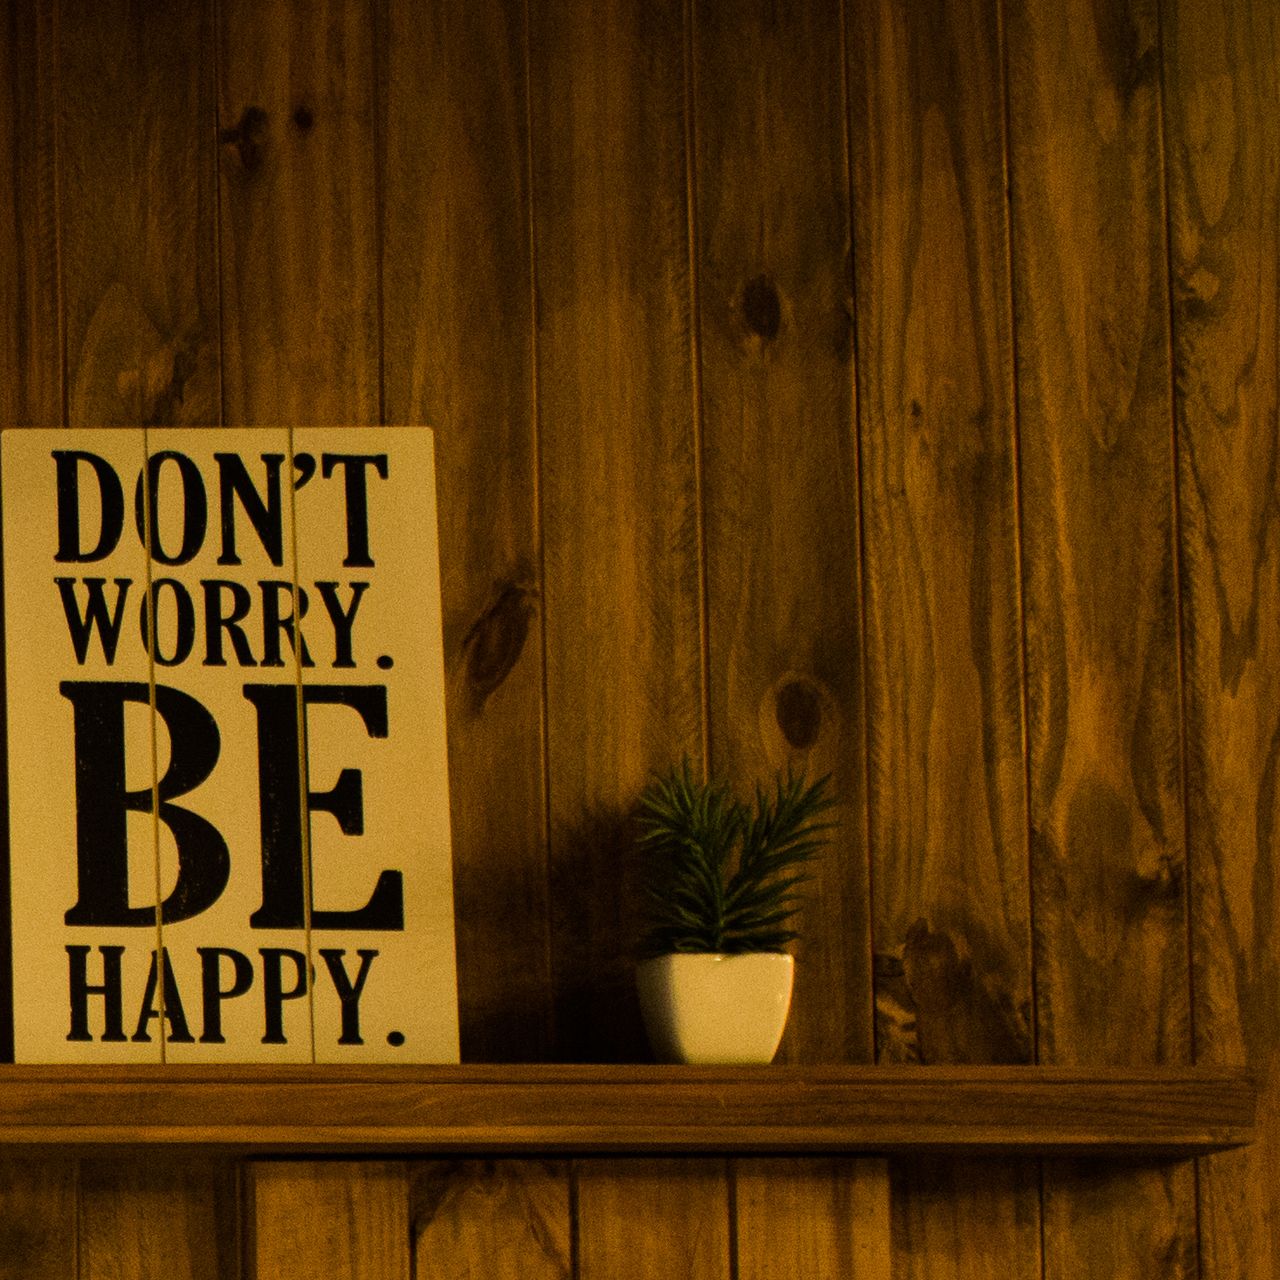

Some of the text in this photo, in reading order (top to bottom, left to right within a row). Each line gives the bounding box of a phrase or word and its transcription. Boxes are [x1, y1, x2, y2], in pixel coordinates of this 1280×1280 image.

[51, 450, 390, 568] DON'T
[53, 577, 395, 670] WORRY.
[58, 680, 406, 931] BE
[64, 945, 406, 1047] HAPPY.
